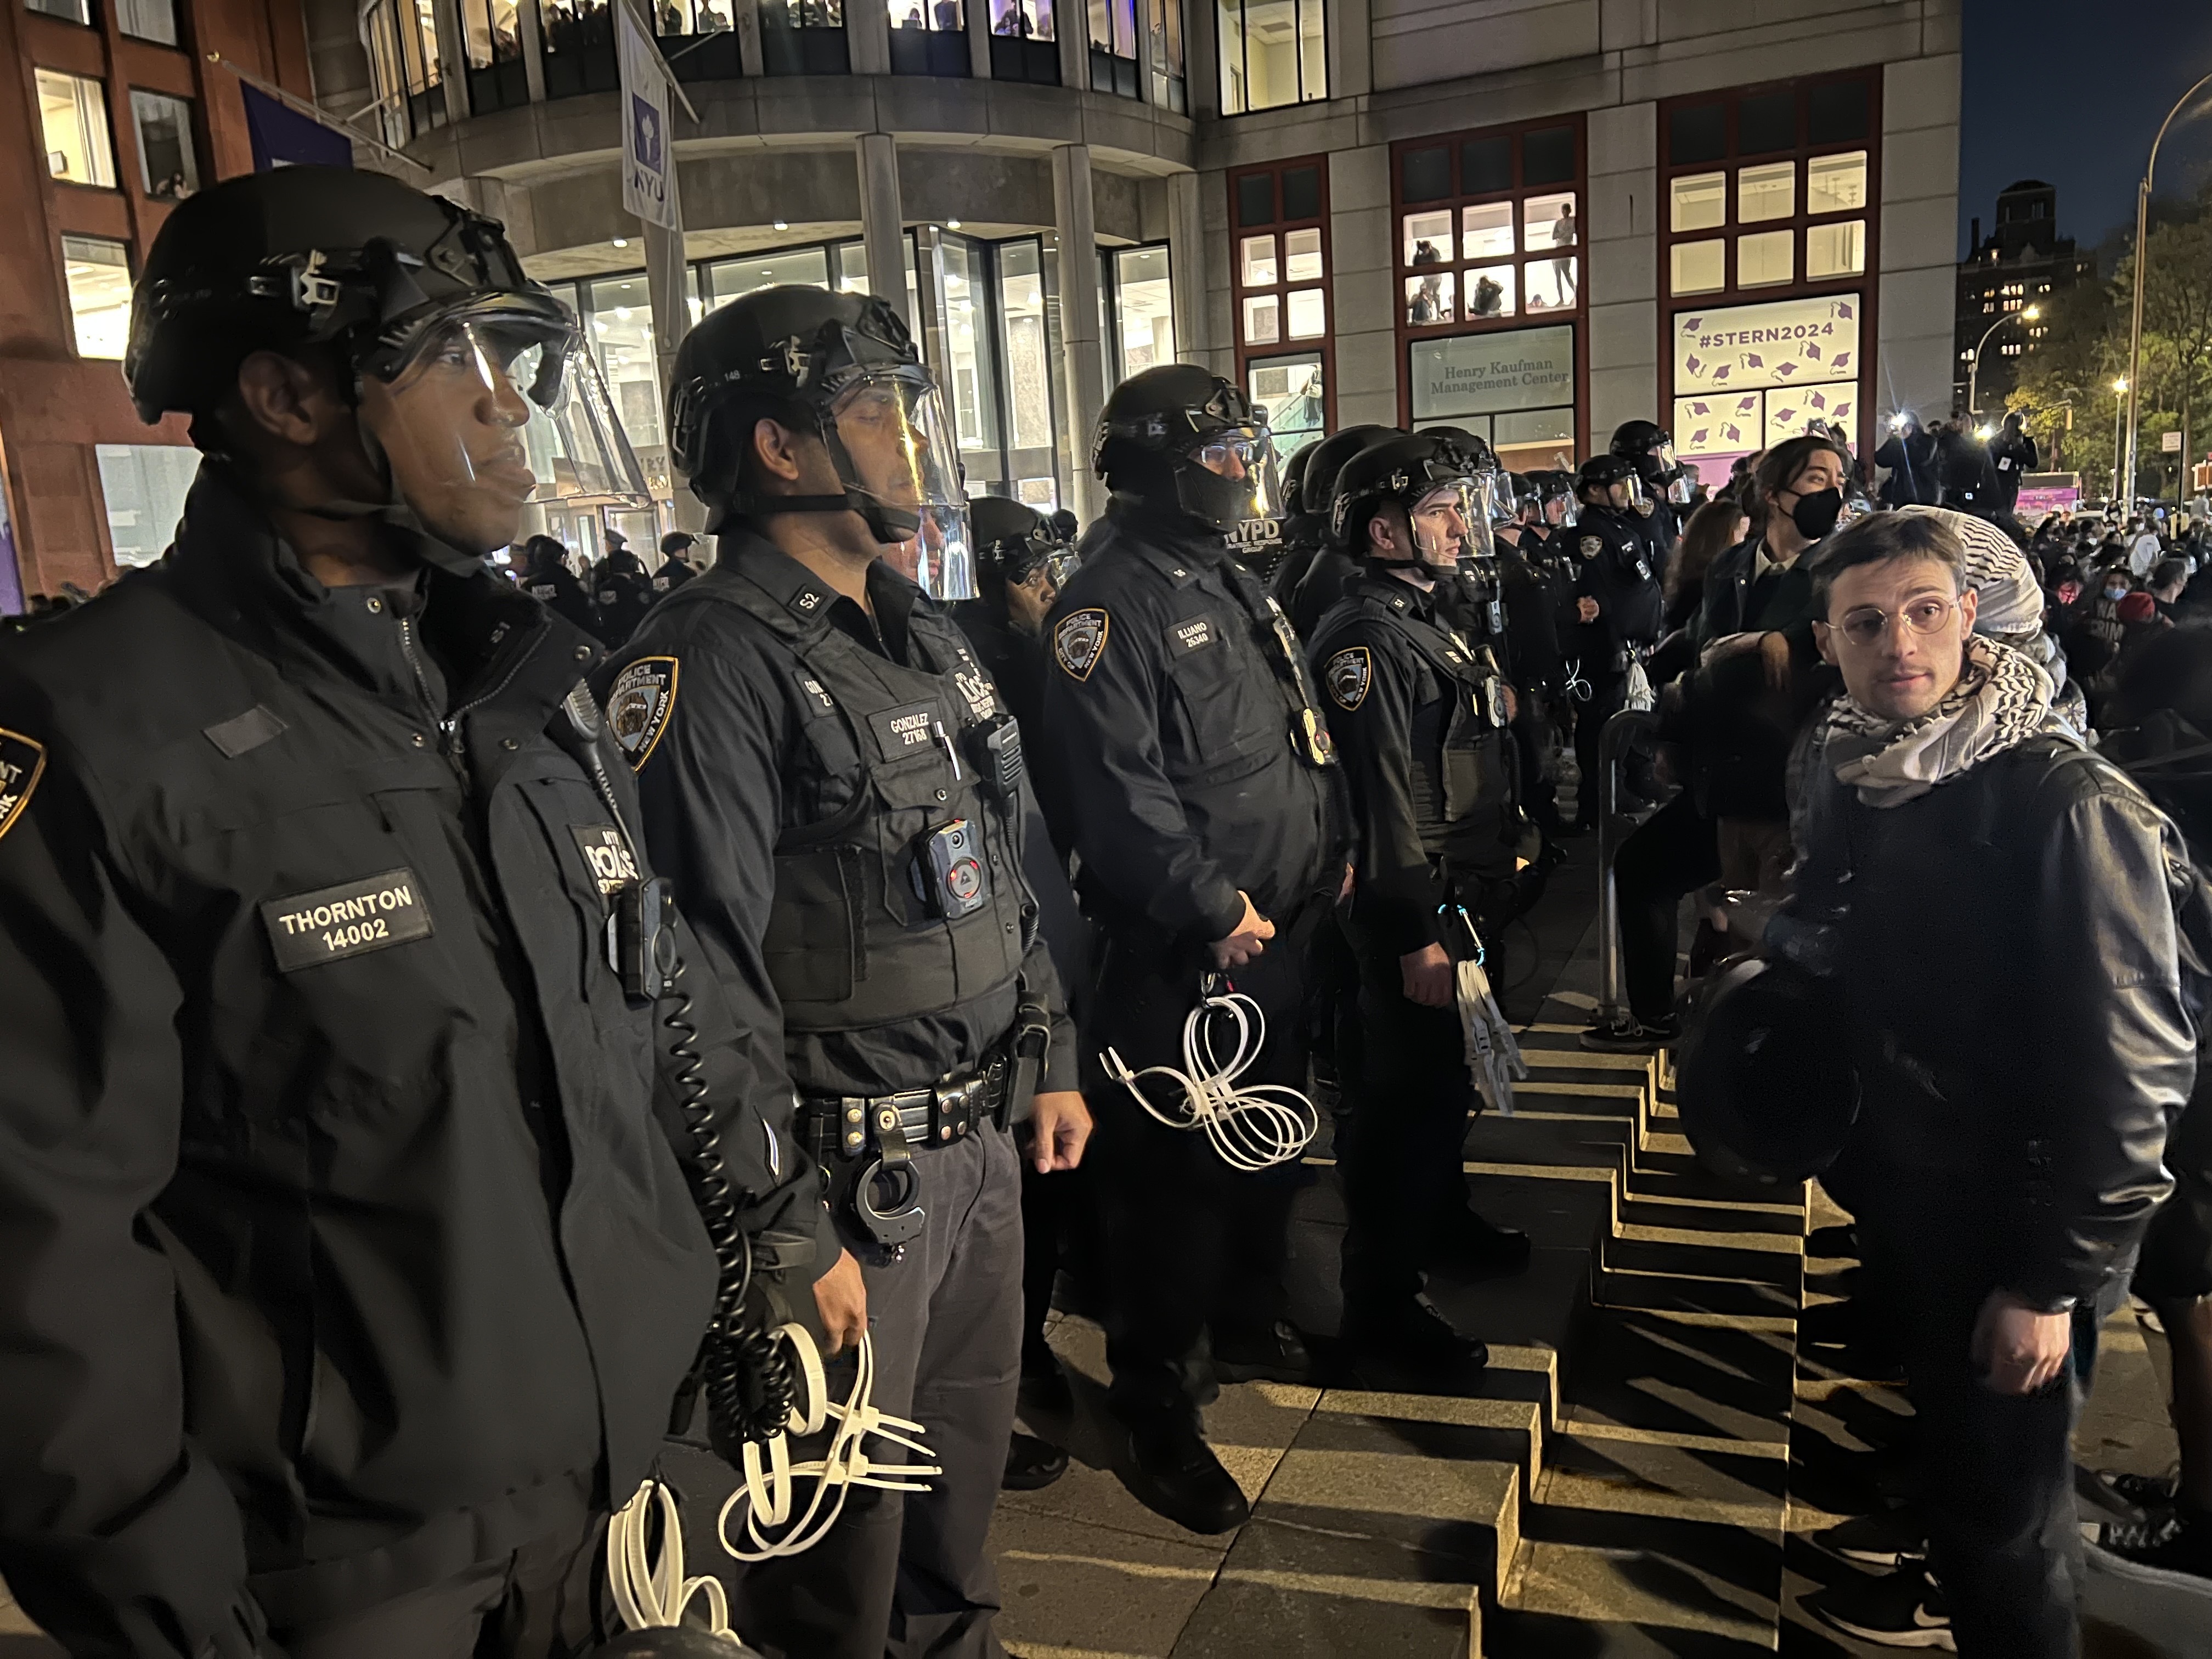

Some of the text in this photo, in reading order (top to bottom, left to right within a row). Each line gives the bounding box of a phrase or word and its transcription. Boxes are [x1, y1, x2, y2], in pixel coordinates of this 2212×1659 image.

[634, 167, 664, 202] NYU
[1700, 322, 1834, 349] #STERN2024
[724, 369, 741, 382] 148
[1444, 359, 1553, 380] Henry Kaufman
[1431, 371, 1568, 394] Management Center
[1224, 520, 1279, 543] NYPD
[799, 592, 819, 609] S2
[1177, 622, 1207, 640] ILLIANO
[1084, 630, 1104, 669] NEW YORK
[618, 664, 651, 688] POLICE
[637, 690, 670, 753] NEW YORK
[890, 713, 929, 733] GONZALEZ
[279, 885, 413, 935] THORNTON
[323, 918, 389, 951] 14002
